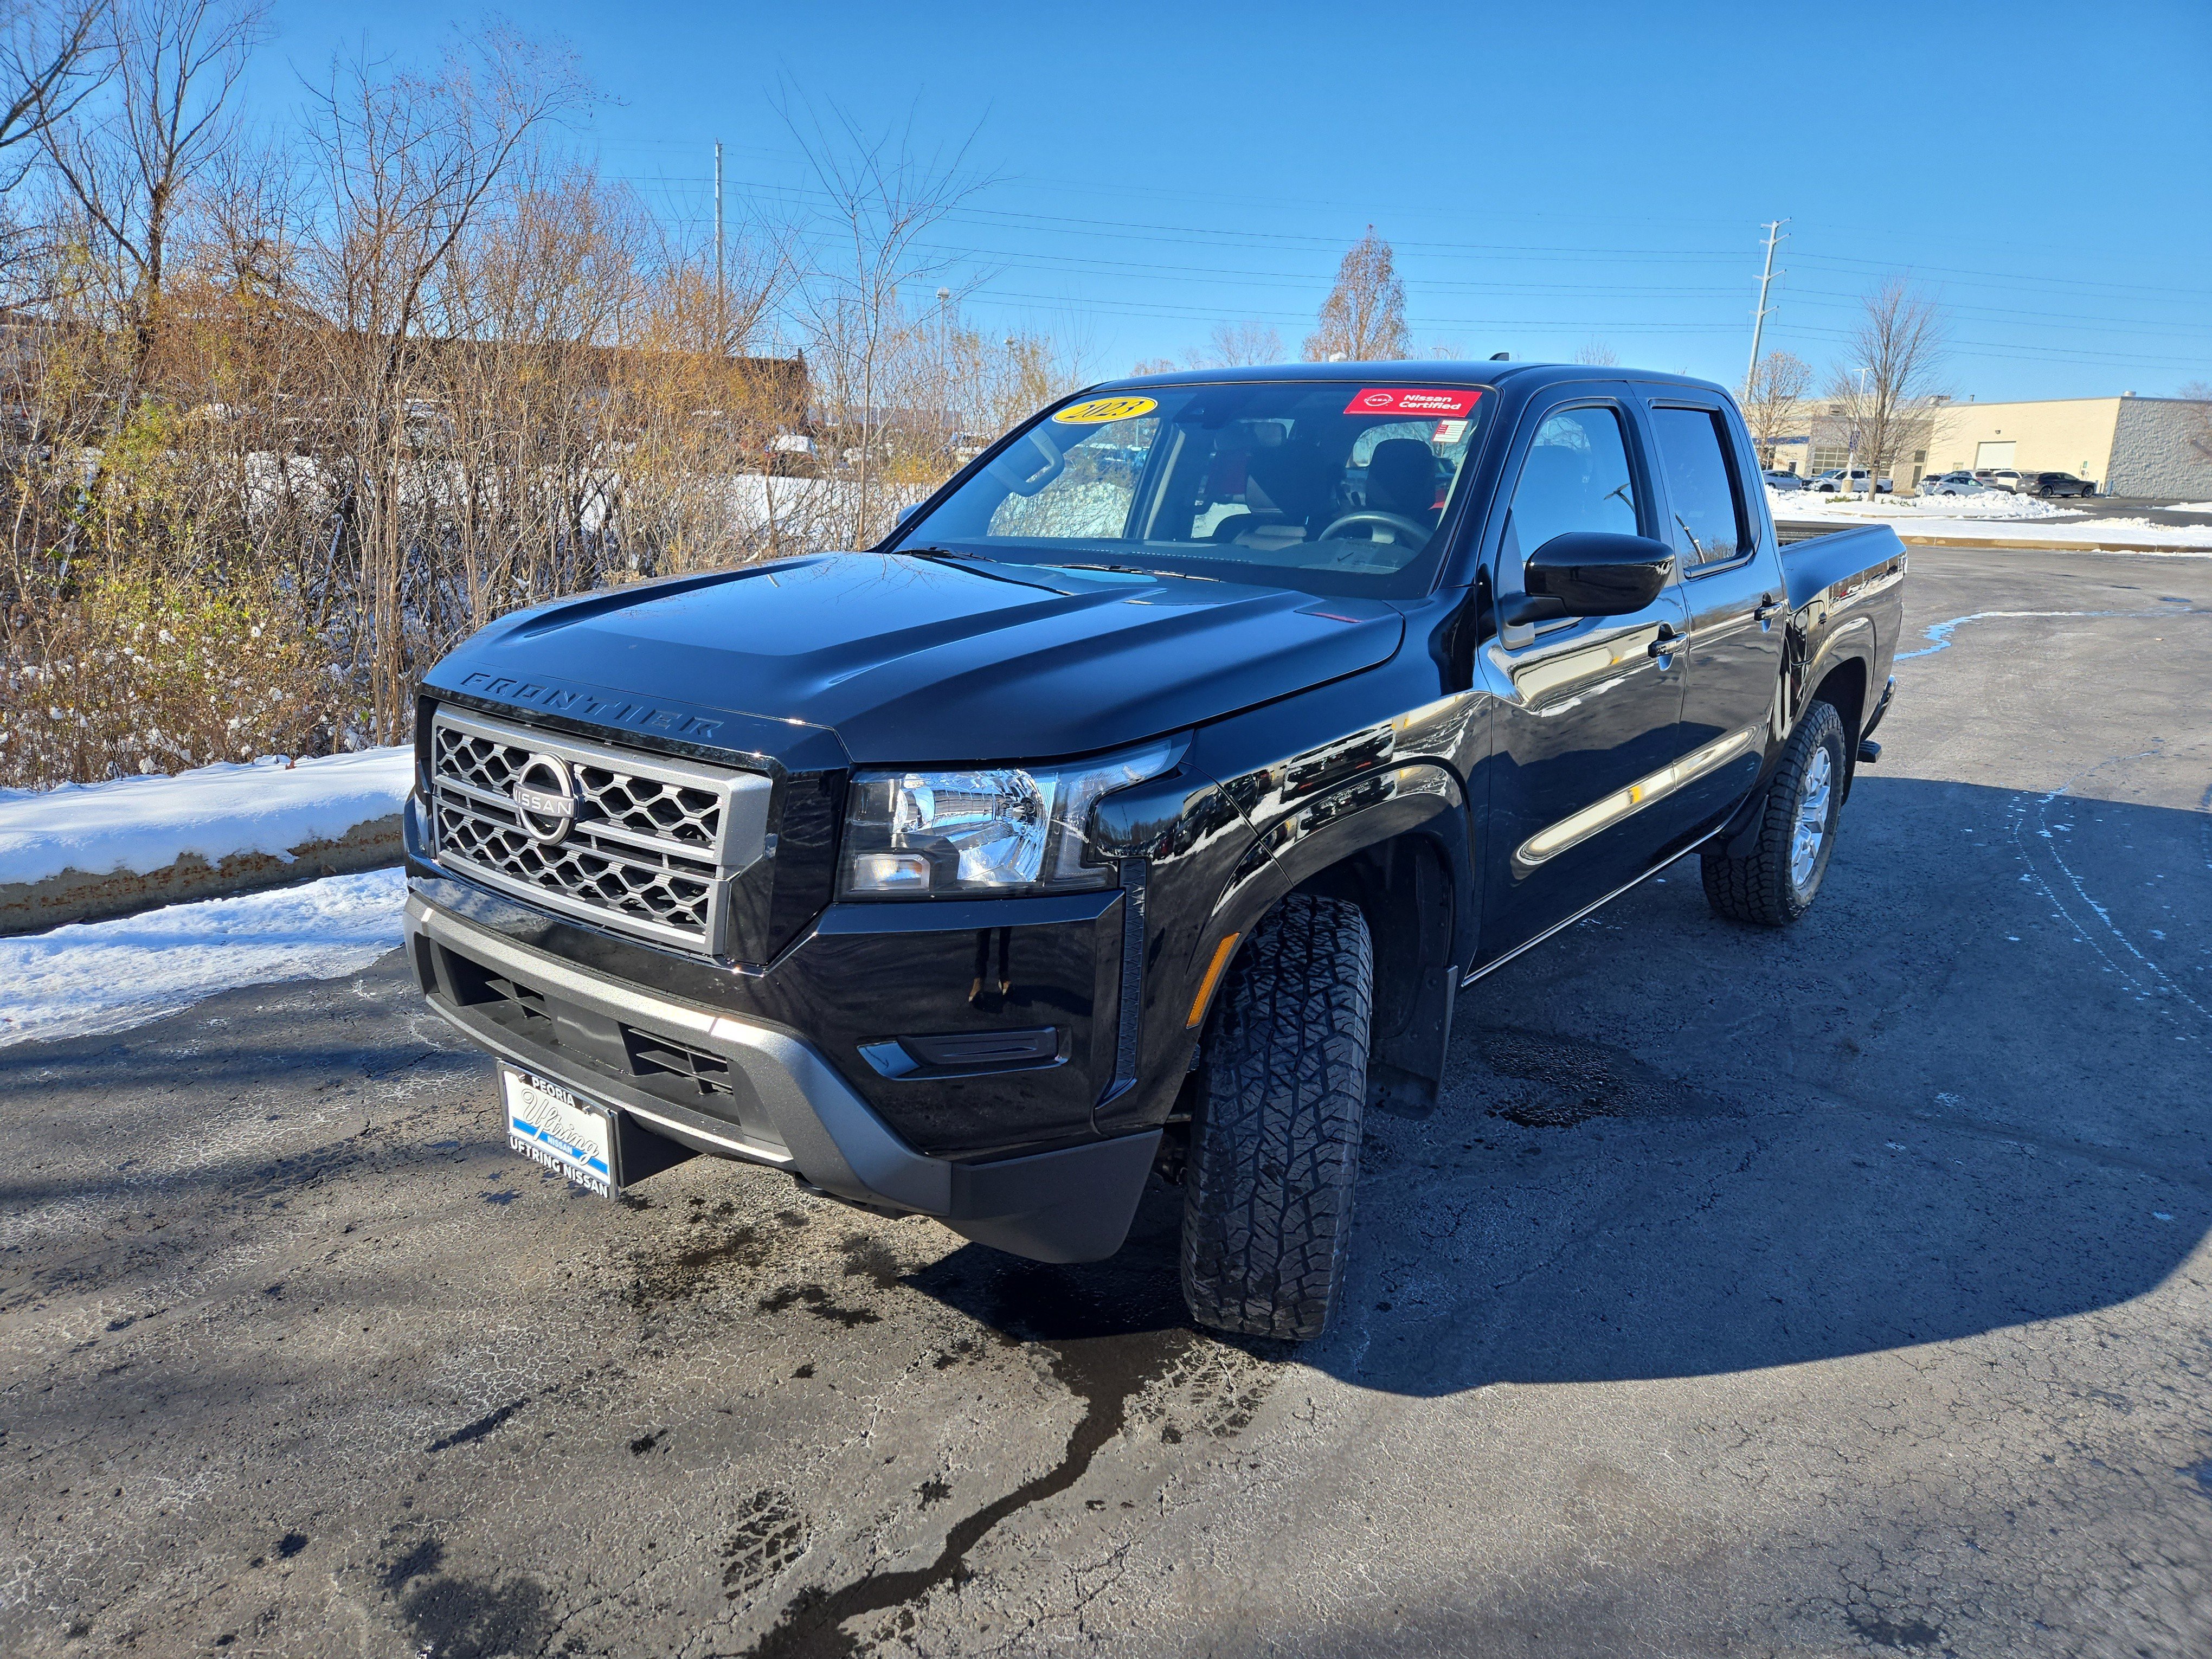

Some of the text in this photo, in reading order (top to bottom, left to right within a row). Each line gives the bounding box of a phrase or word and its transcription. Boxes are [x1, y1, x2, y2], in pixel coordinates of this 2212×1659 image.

[1063, 401, 1145, 419] 2023
[1399, 401, 1462, 410] Certified
[1404, 394, 1452, 402] Nissan
[460, 672, 724, 738] FRONTIER
[513, 787, 572, 815] NISSAN
[531, 1076, 576, 1108] PEORIA
[521, 1088, 600, 1166] Uftring
[547, 1135, 573, 1155] NISSAN
[510, 1136, 608, 1199] UFTRING NISSAN
